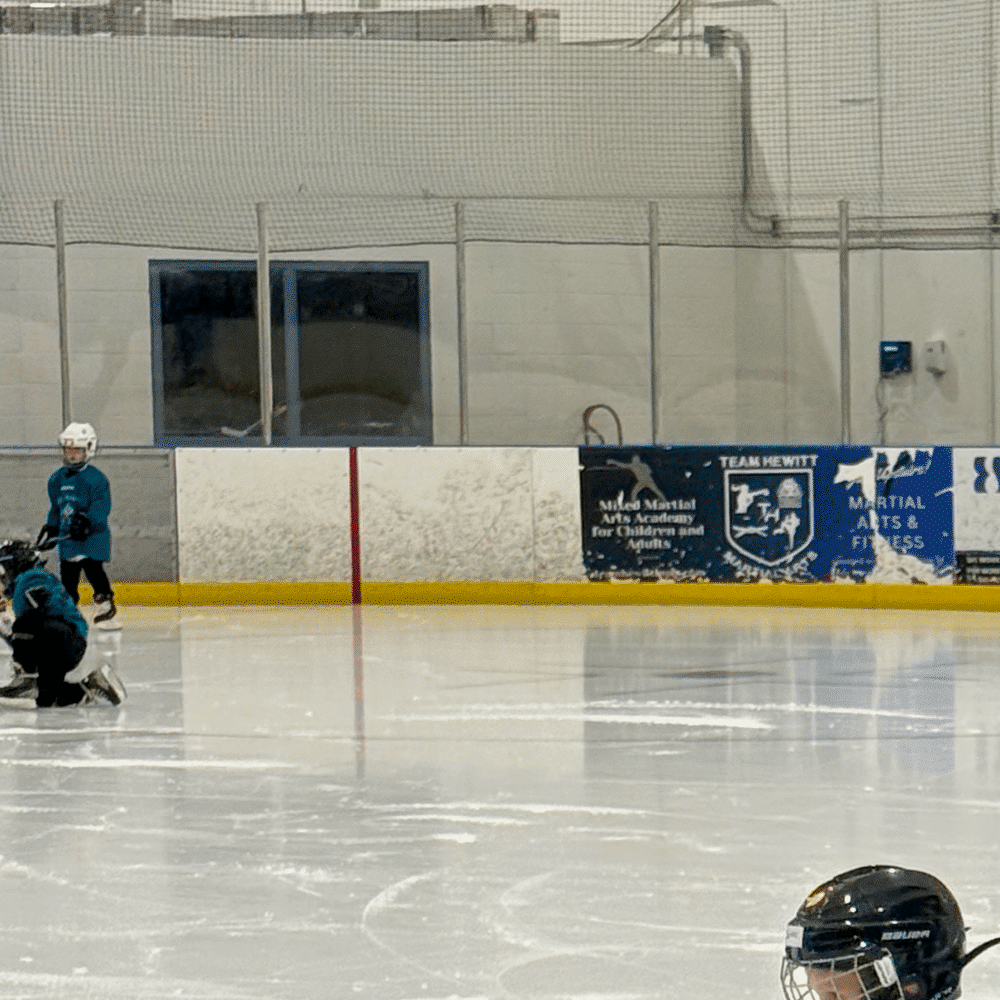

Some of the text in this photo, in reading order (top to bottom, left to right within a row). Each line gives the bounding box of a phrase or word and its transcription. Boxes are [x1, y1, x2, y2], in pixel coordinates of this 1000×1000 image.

[719, 454, 819, 468] TEAM HEWITT
[599, 498, 697, 511] Mixed Martial
[849, 495, 926, 510] MARTIAL
[602, 512, 696, 526] Arts Academy
[856, 515, 920, 530] ATS &
[591, 524, 705, 537] for Children and
[626, 537, 672, 550] Adults
[851, 535, 926, 551] FITESS
